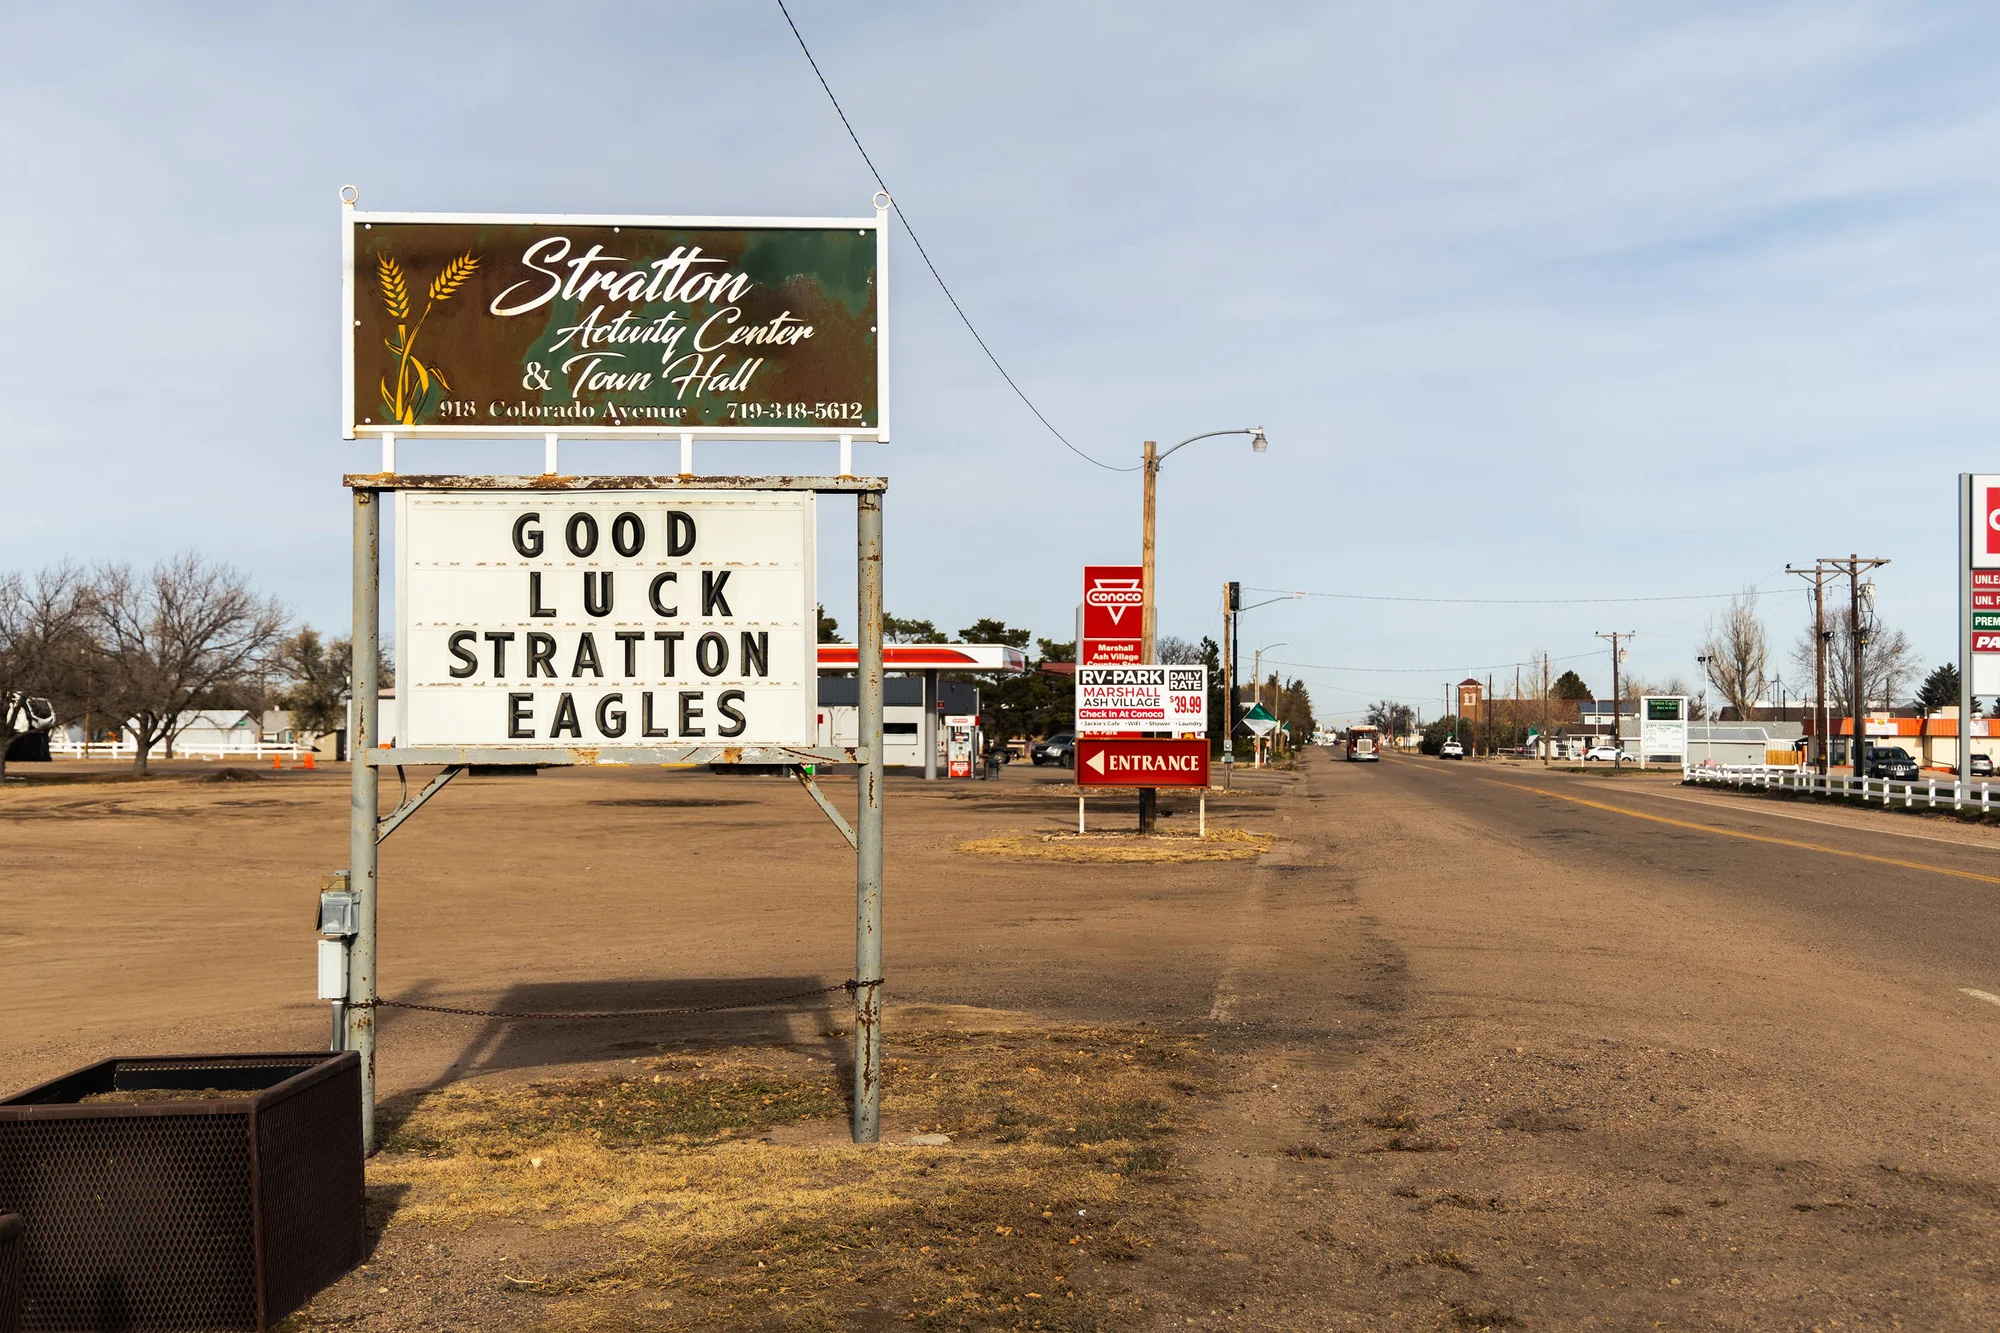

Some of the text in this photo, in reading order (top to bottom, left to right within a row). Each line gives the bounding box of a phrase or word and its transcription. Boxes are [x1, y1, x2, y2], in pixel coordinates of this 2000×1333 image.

[490, 236, 753, 316] Stratton
[549, 305, 815, 364] Activity Center
[522, 352, 764, 400] & Town Hall
[440, 400, 863, 420] 918 Colorado Avenue 719-348-5612
[512, 511, 697, 558] GOOD
[529, 571, 733, 618] LUCK
[1975, 596, 1994, 605] UNL
[448, 630, 768, 678] STRATTON
[1110, 653, 1139, 661] Village
[1082, 671, 1162, 684] RV-PARK
[1170, 672, 1201, 680] DAILY
[1084, 687, 1161, 697] MARSHALL
[1170, 681, 1201, 690] RATE
[1084, 698, 1160, 707] ASH VILLAGE
[1169, 695, 1201, 713] $39.99
[508, 690, 747, 738] EAGLES
[1080, 710, 1164, 718] Check In At Conoco
[1109, 755, 1200, 771] ENTRANCE
